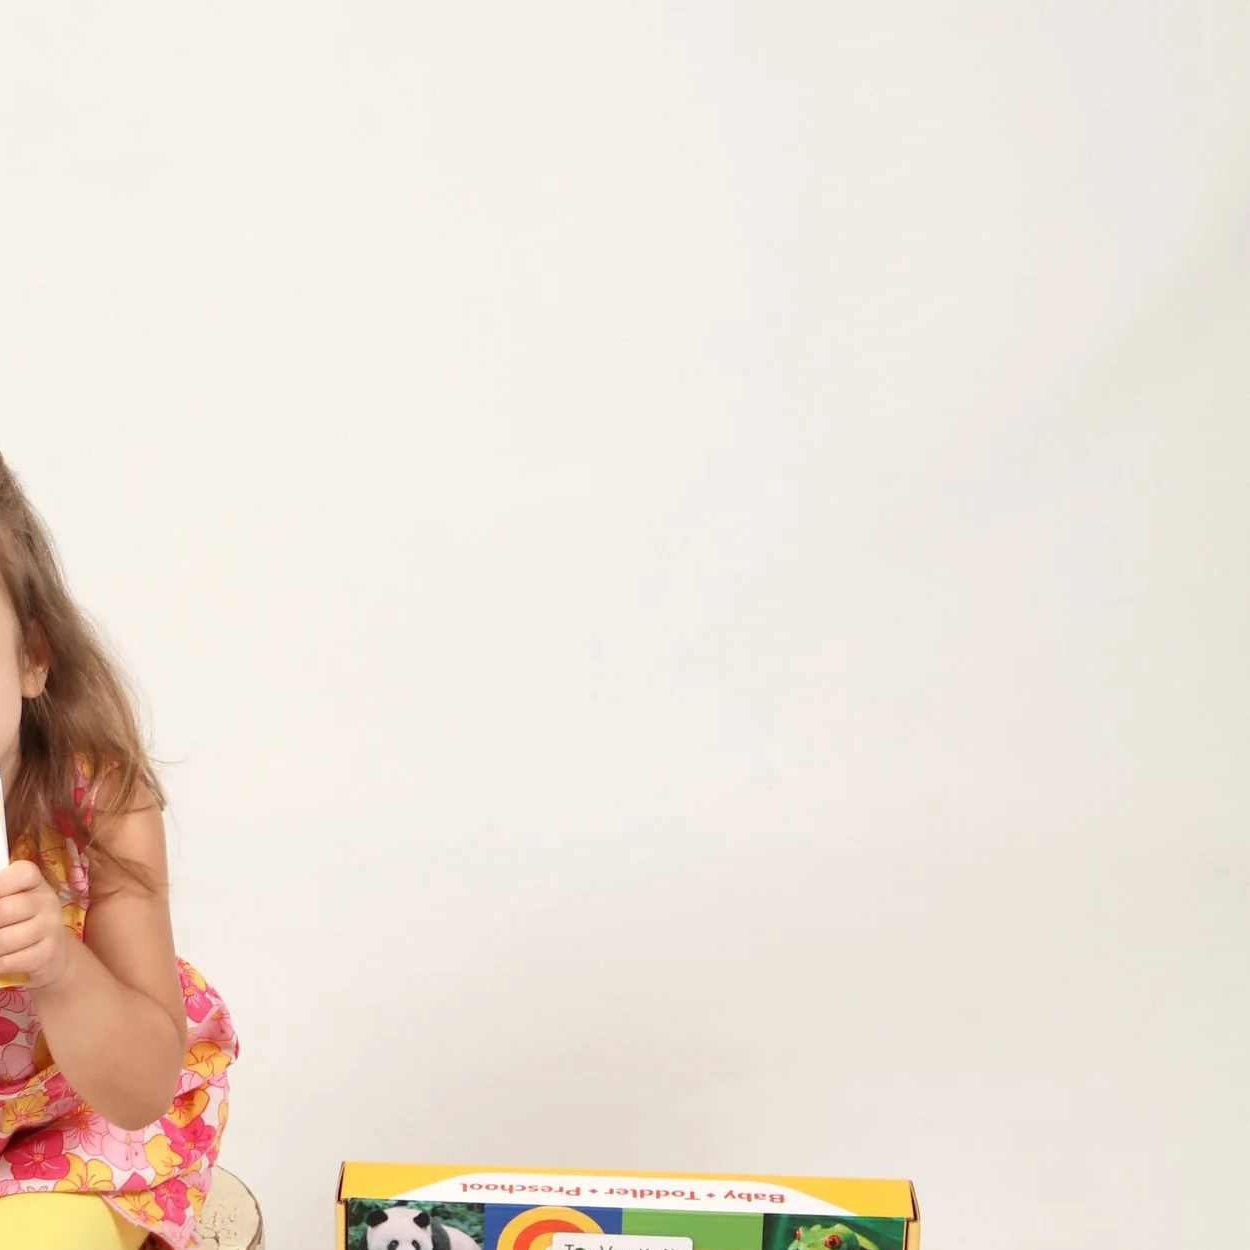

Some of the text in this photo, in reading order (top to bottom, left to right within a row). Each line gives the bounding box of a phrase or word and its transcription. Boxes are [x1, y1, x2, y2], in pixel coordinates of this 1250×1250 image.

[460, 1182, 786, 1204] Baby Toddler Preschool
